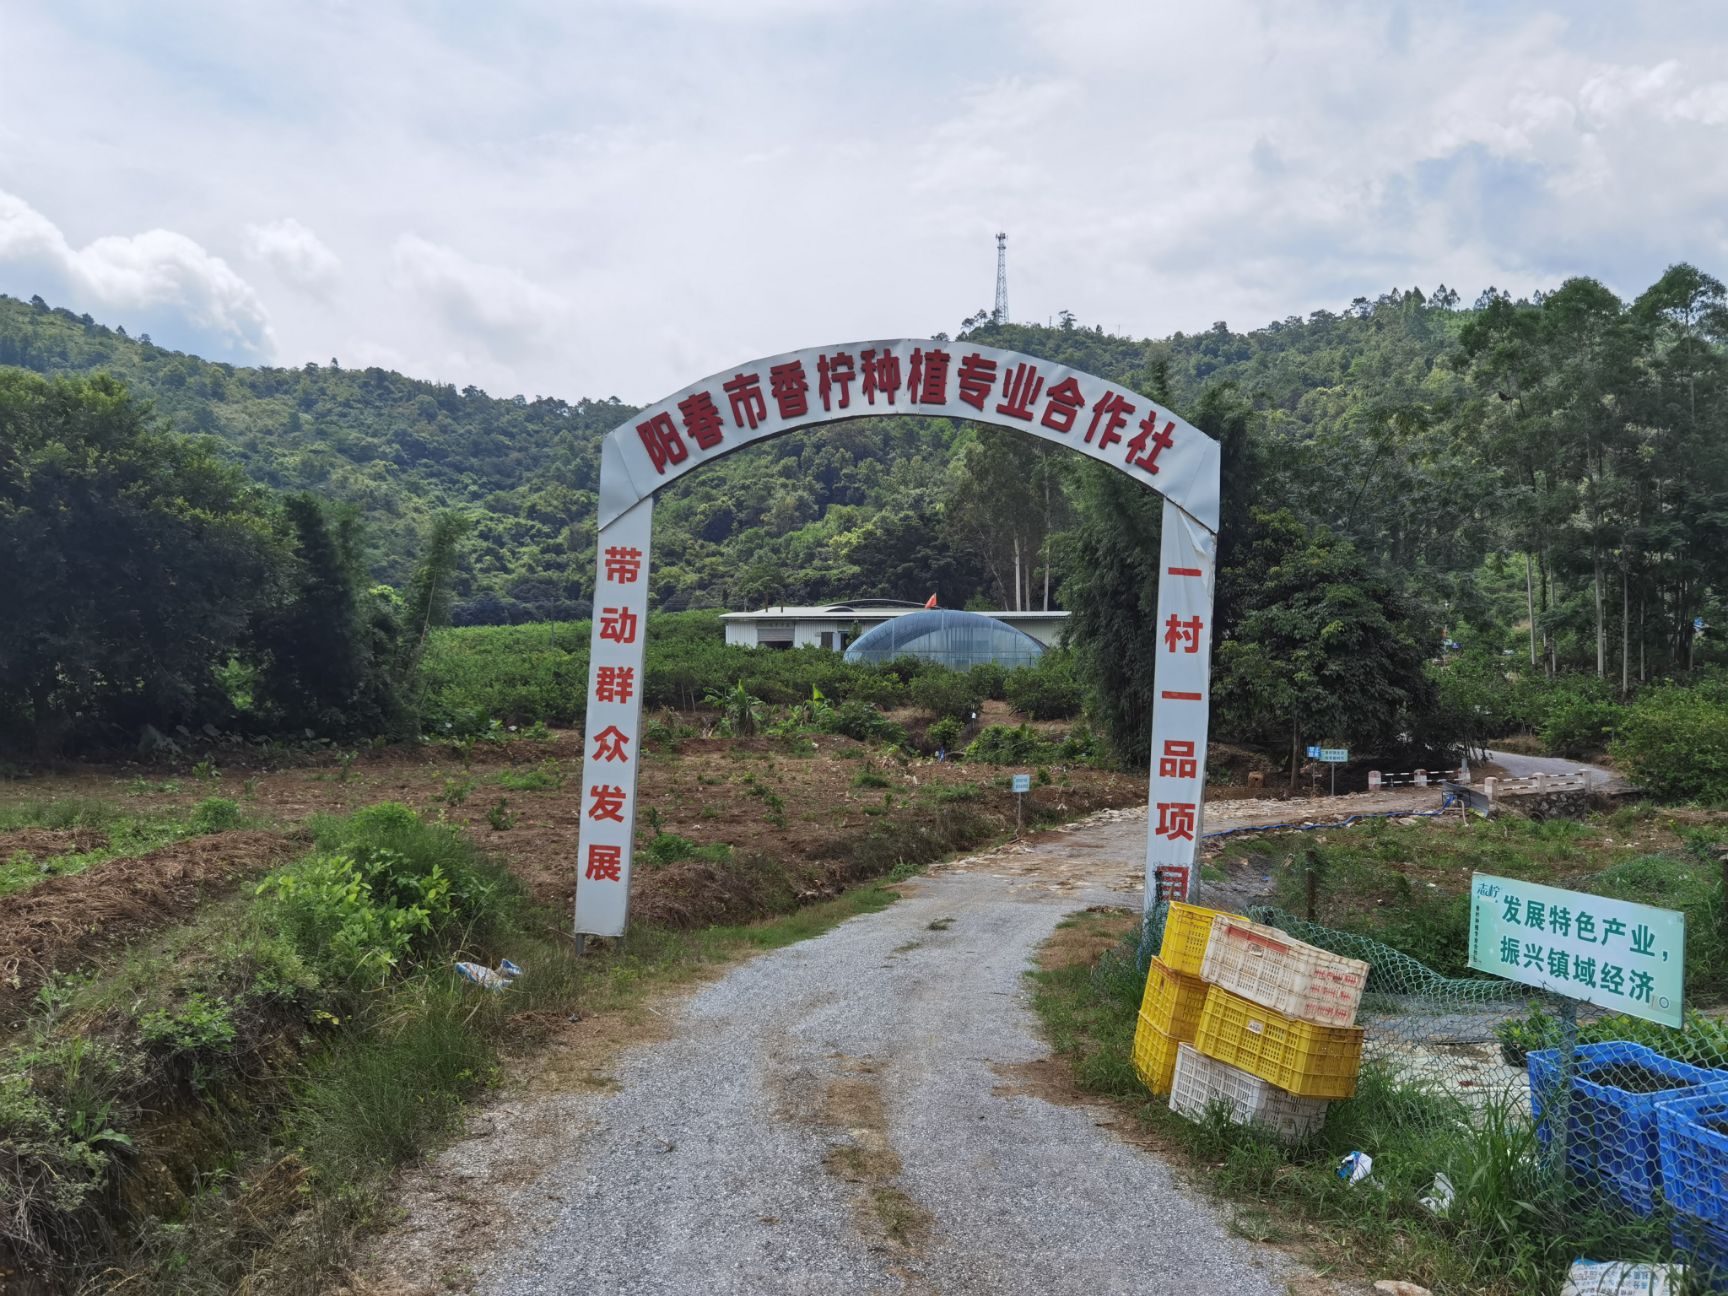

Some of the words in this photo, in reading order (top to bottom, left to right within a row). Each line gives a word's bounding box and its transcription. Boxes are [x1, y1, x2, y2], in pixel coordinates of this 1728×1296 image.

[636, 347, 1175, 475] 阳春市香柠种植专业合作社
[585, 546, 643, 882] 带动群众发展
